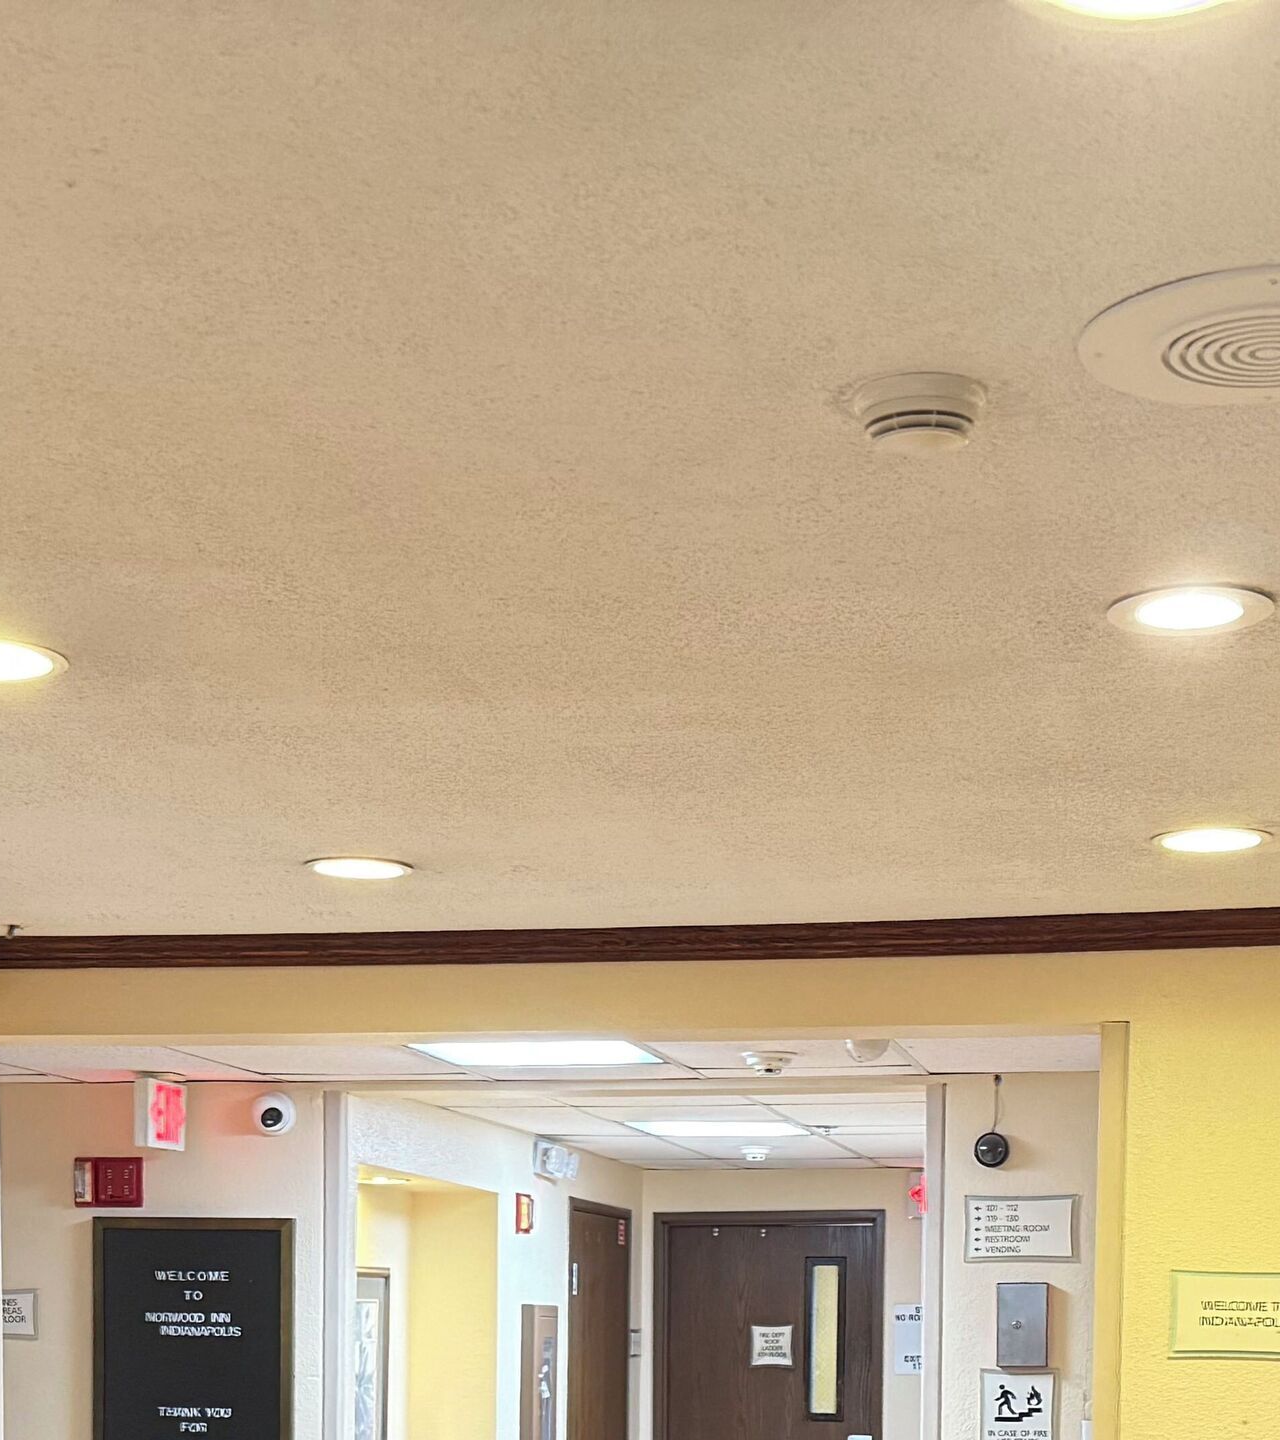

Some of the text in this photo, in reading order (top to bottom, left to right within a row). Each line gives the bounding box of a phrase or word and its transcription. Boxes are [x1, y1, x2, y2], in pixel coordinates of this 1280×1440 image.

[154, 1270, 230, 1281] WELCOME
[184, 1290, 203, 1301] TO
[1200, 1300, 1268, 1311] WELCOME
[145, 1312, 231, 1323] NORWOOD INN
[160, 1326, 242, 1337] INDIANAPOLIS
[157, 1406, 232, 1418] THANK YOU
[180, 1422, 208, 1433] FOR
